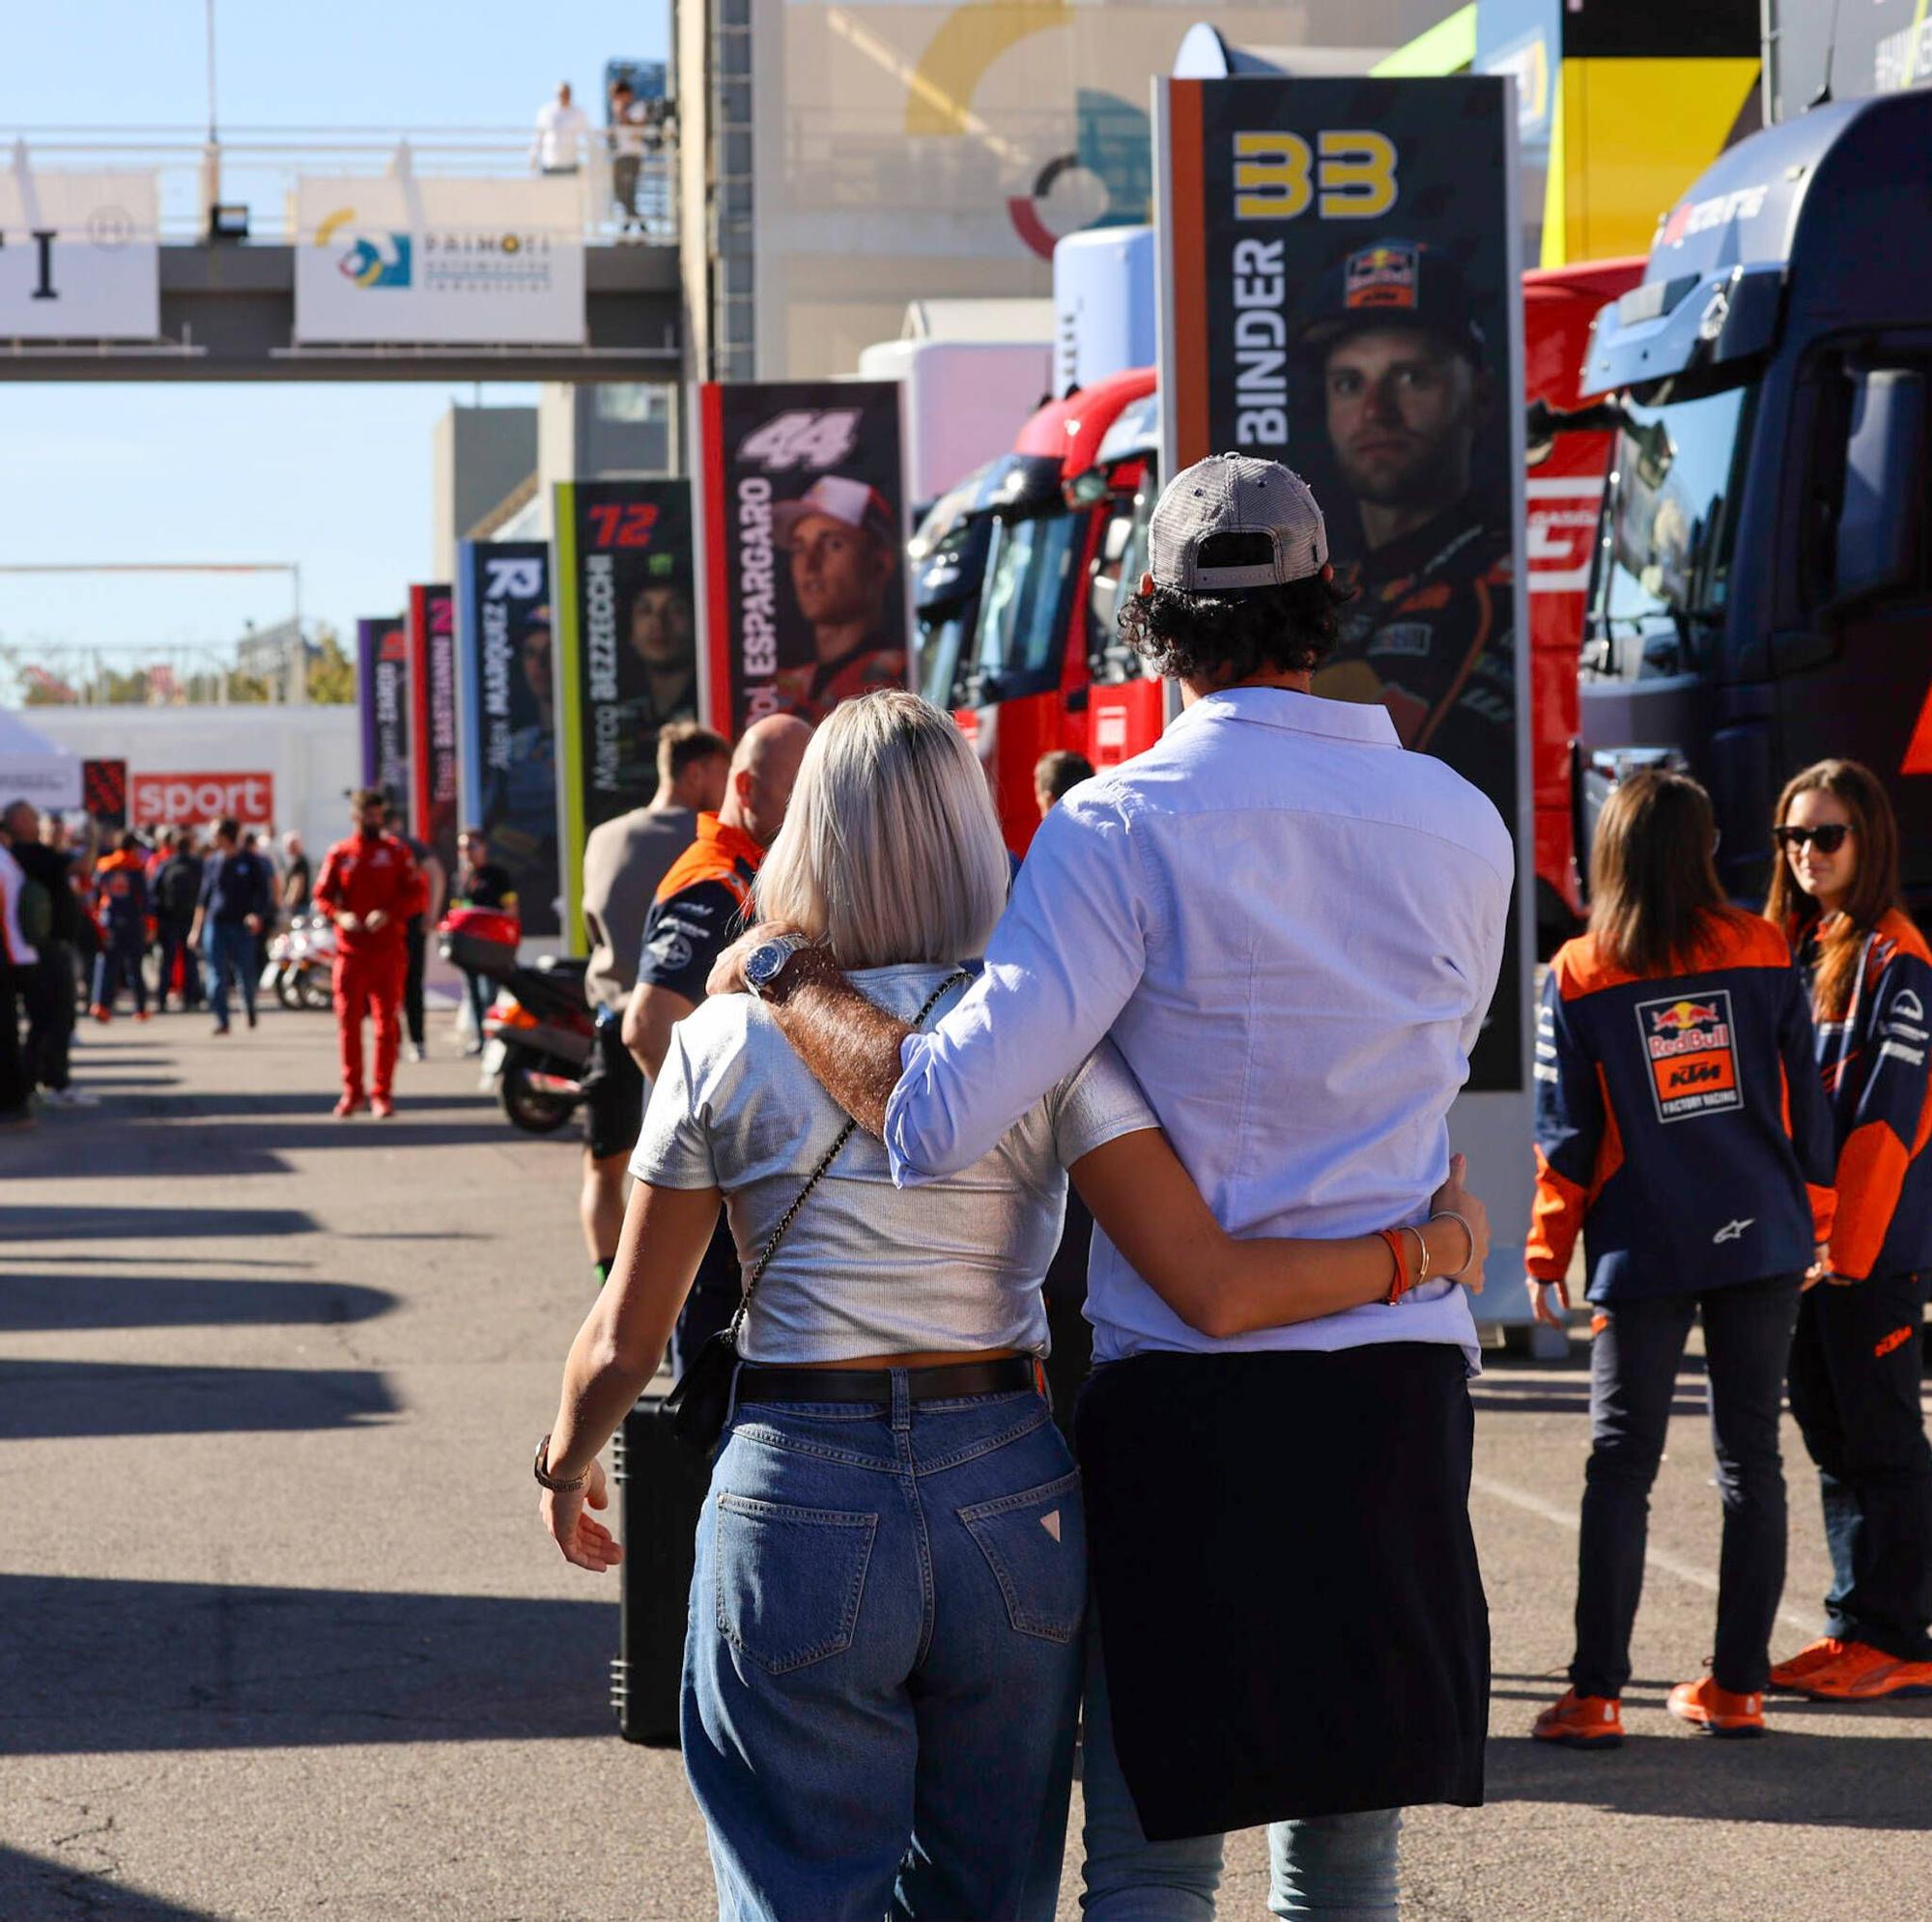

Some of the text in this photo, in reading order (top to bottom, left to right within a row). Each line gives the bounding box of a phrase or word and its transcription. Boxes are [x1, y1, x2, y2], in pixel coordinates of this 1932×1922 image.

[1233, 239, 1289, 444] BINDER
[738, 410, 859, 470] 44
[587, 503, 659, 548] 72
[738, 477, 779, 728] ol ESPARGARO
[482, 601, 514, 715] MARQUEZ
[586, 554, 621, 792] Marco BEZZECCHI
[139, 780, 266, 819] sport
[1669, 1063, 1723, 1088] KTM
